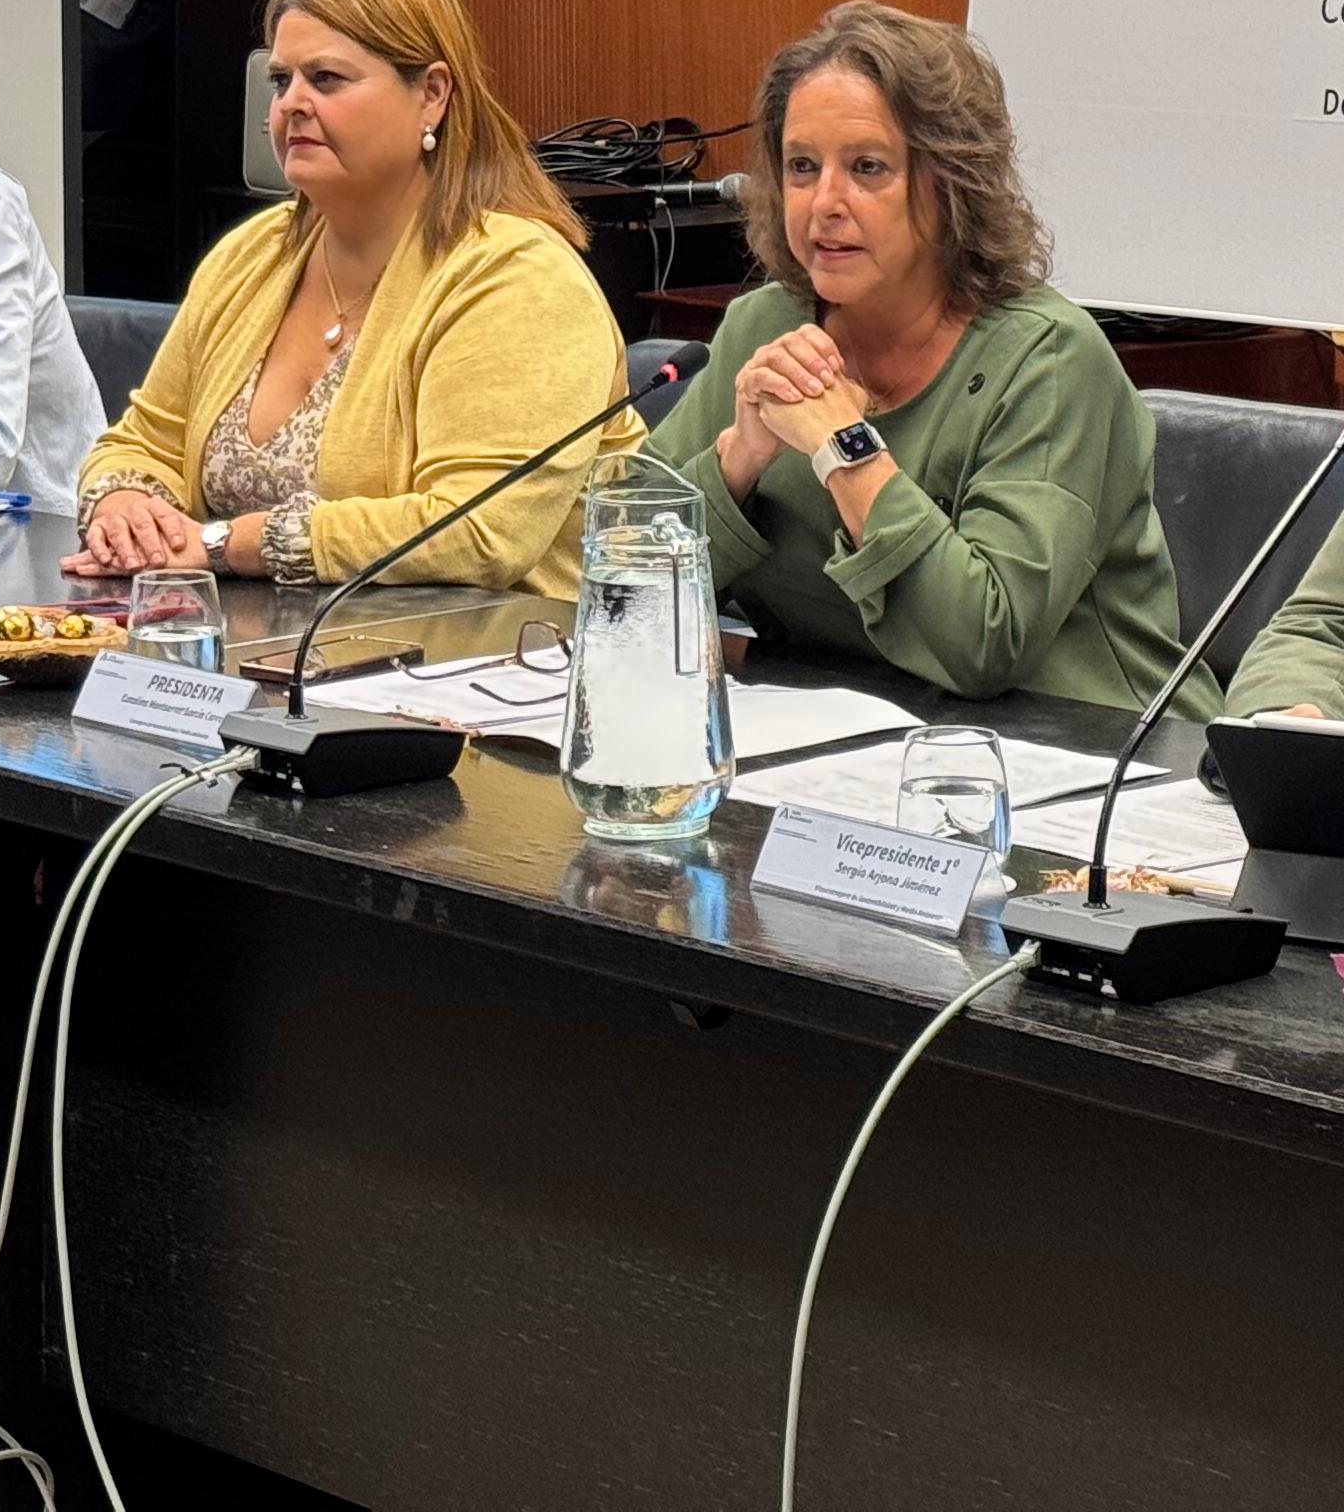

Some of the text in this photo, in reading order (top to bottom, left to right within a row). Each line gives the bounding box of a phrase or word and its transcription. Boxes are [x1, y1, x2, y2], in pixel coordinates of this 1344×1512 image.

[146, 674, 226, 705] PRESIDENTA
[835, 832, 940, 872] Vicepresidente
[940, 858, 961, 875] 1º
[834, 861, 942, 896] Sergio Arjona Jiménez
